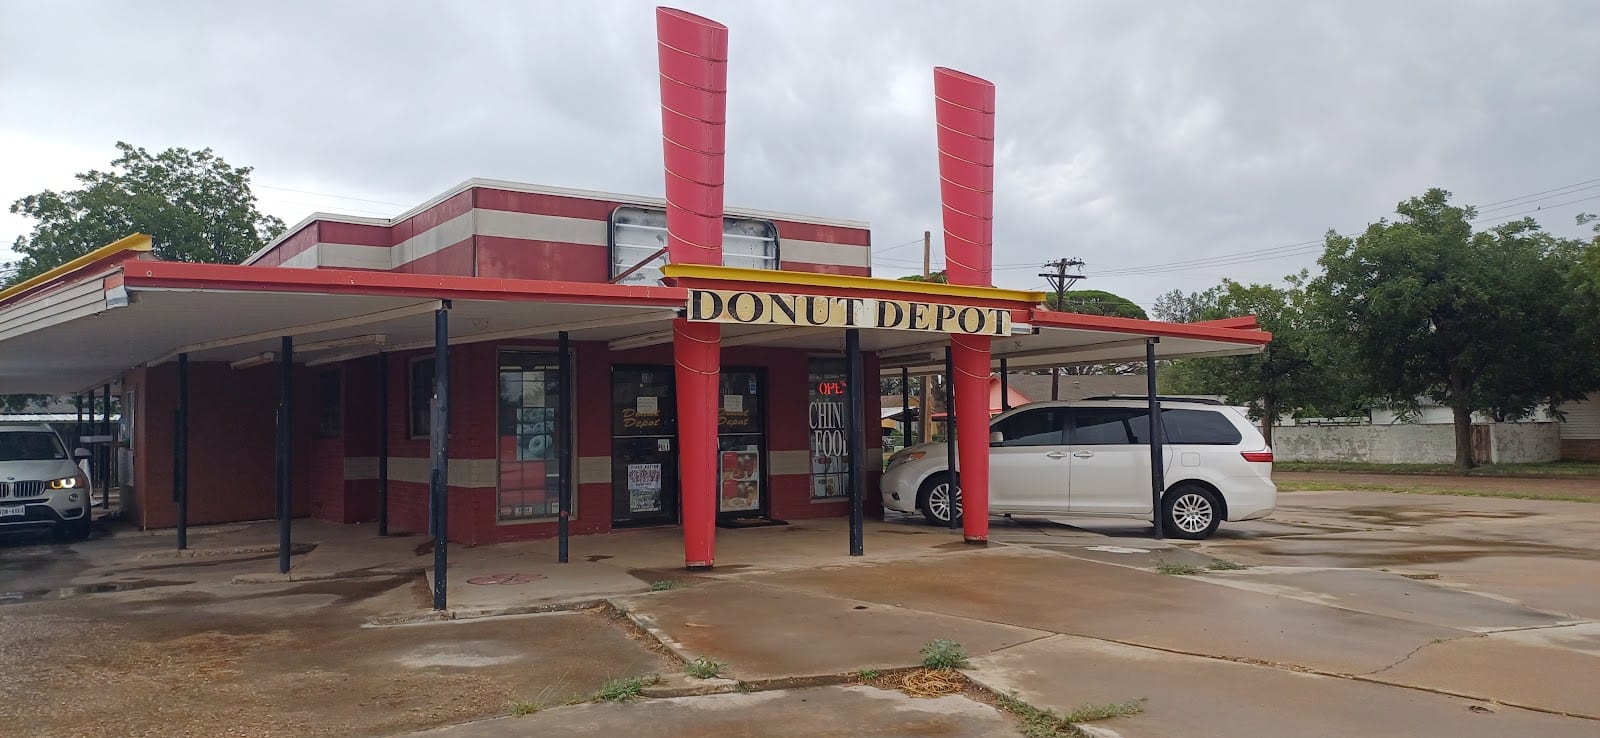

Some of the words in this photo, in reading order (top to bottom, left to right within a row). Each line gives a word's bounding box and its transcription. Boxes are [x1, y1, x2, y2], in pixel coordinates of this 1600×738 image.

[690, 290, 864, 327] DONUT
[876, 300, 1012, 335] DEPOT
[623, 417, 661, 428] Depot
[809, 402, 845, 429] CHIN
